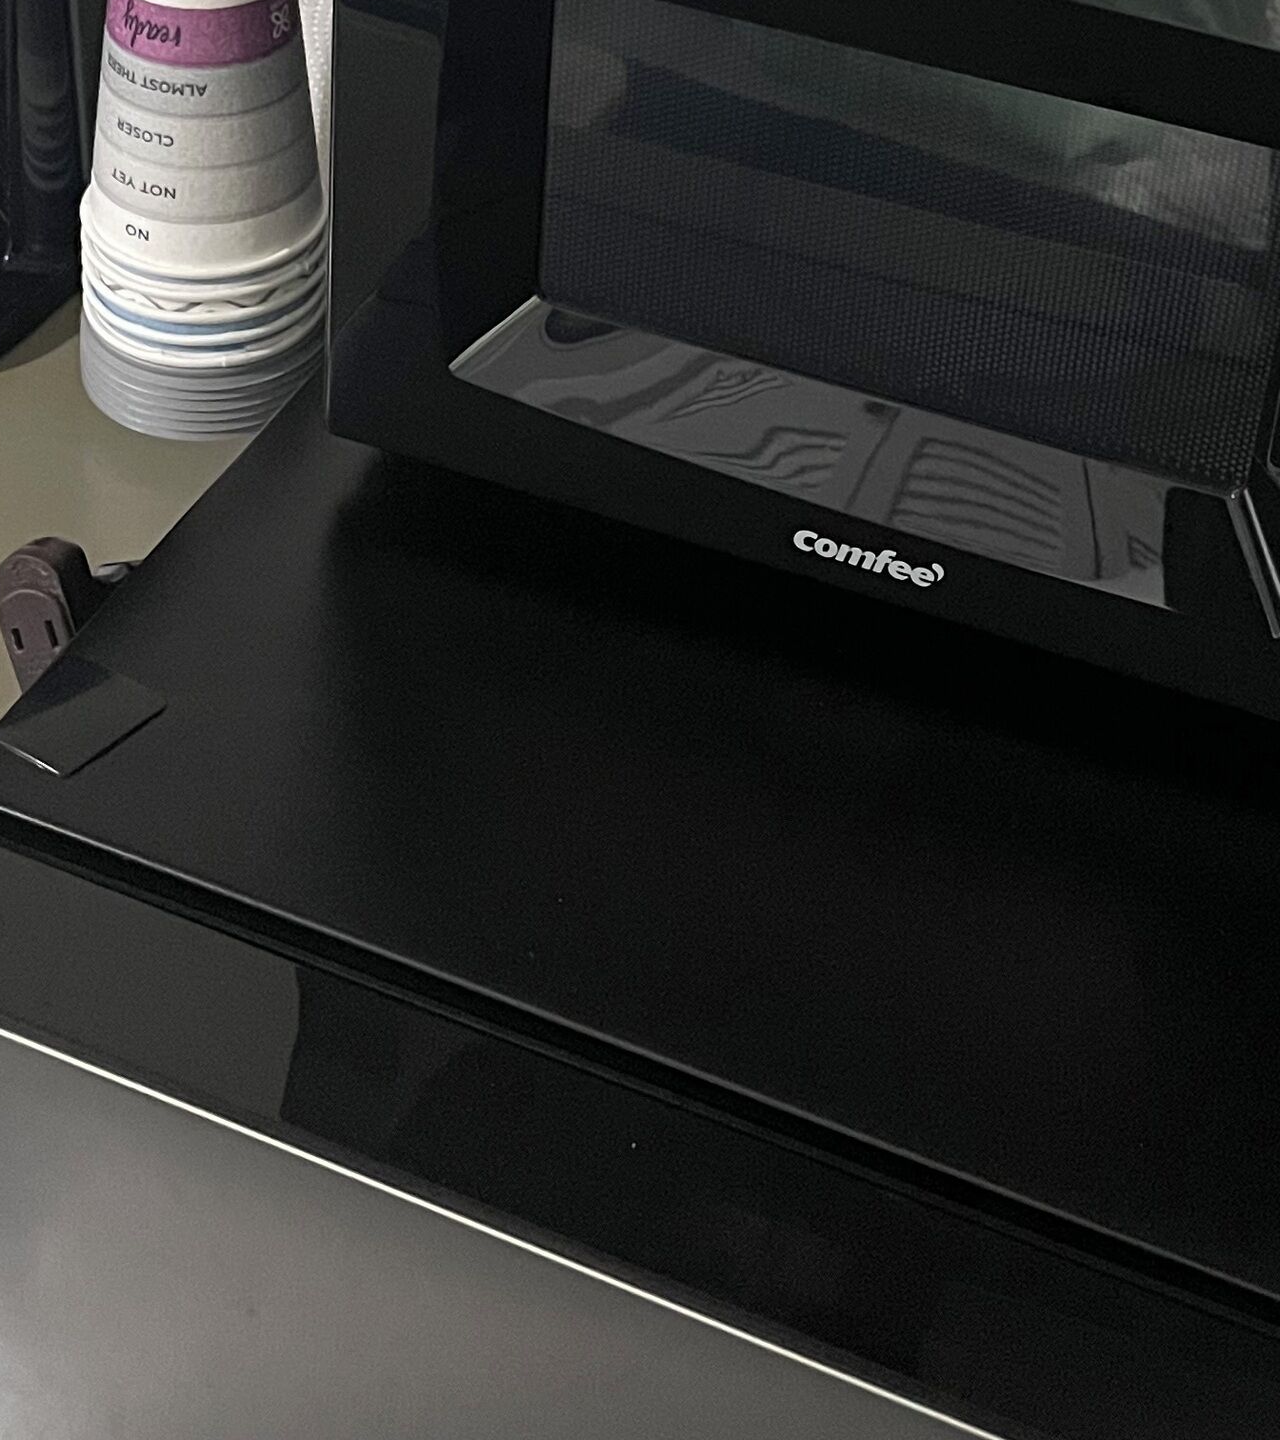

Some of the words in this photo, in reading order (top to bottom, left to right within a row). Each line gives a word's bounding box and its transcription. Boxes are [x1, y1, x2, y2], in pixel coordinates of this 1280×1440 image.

[140, 75, 208, 97] ALMOST
[117, 118, 174, 148] CLOSER
[111, 166, 135, 189] YET
[141, 182, 177, 200] NOT
[124, 223, 150, 242] NO
